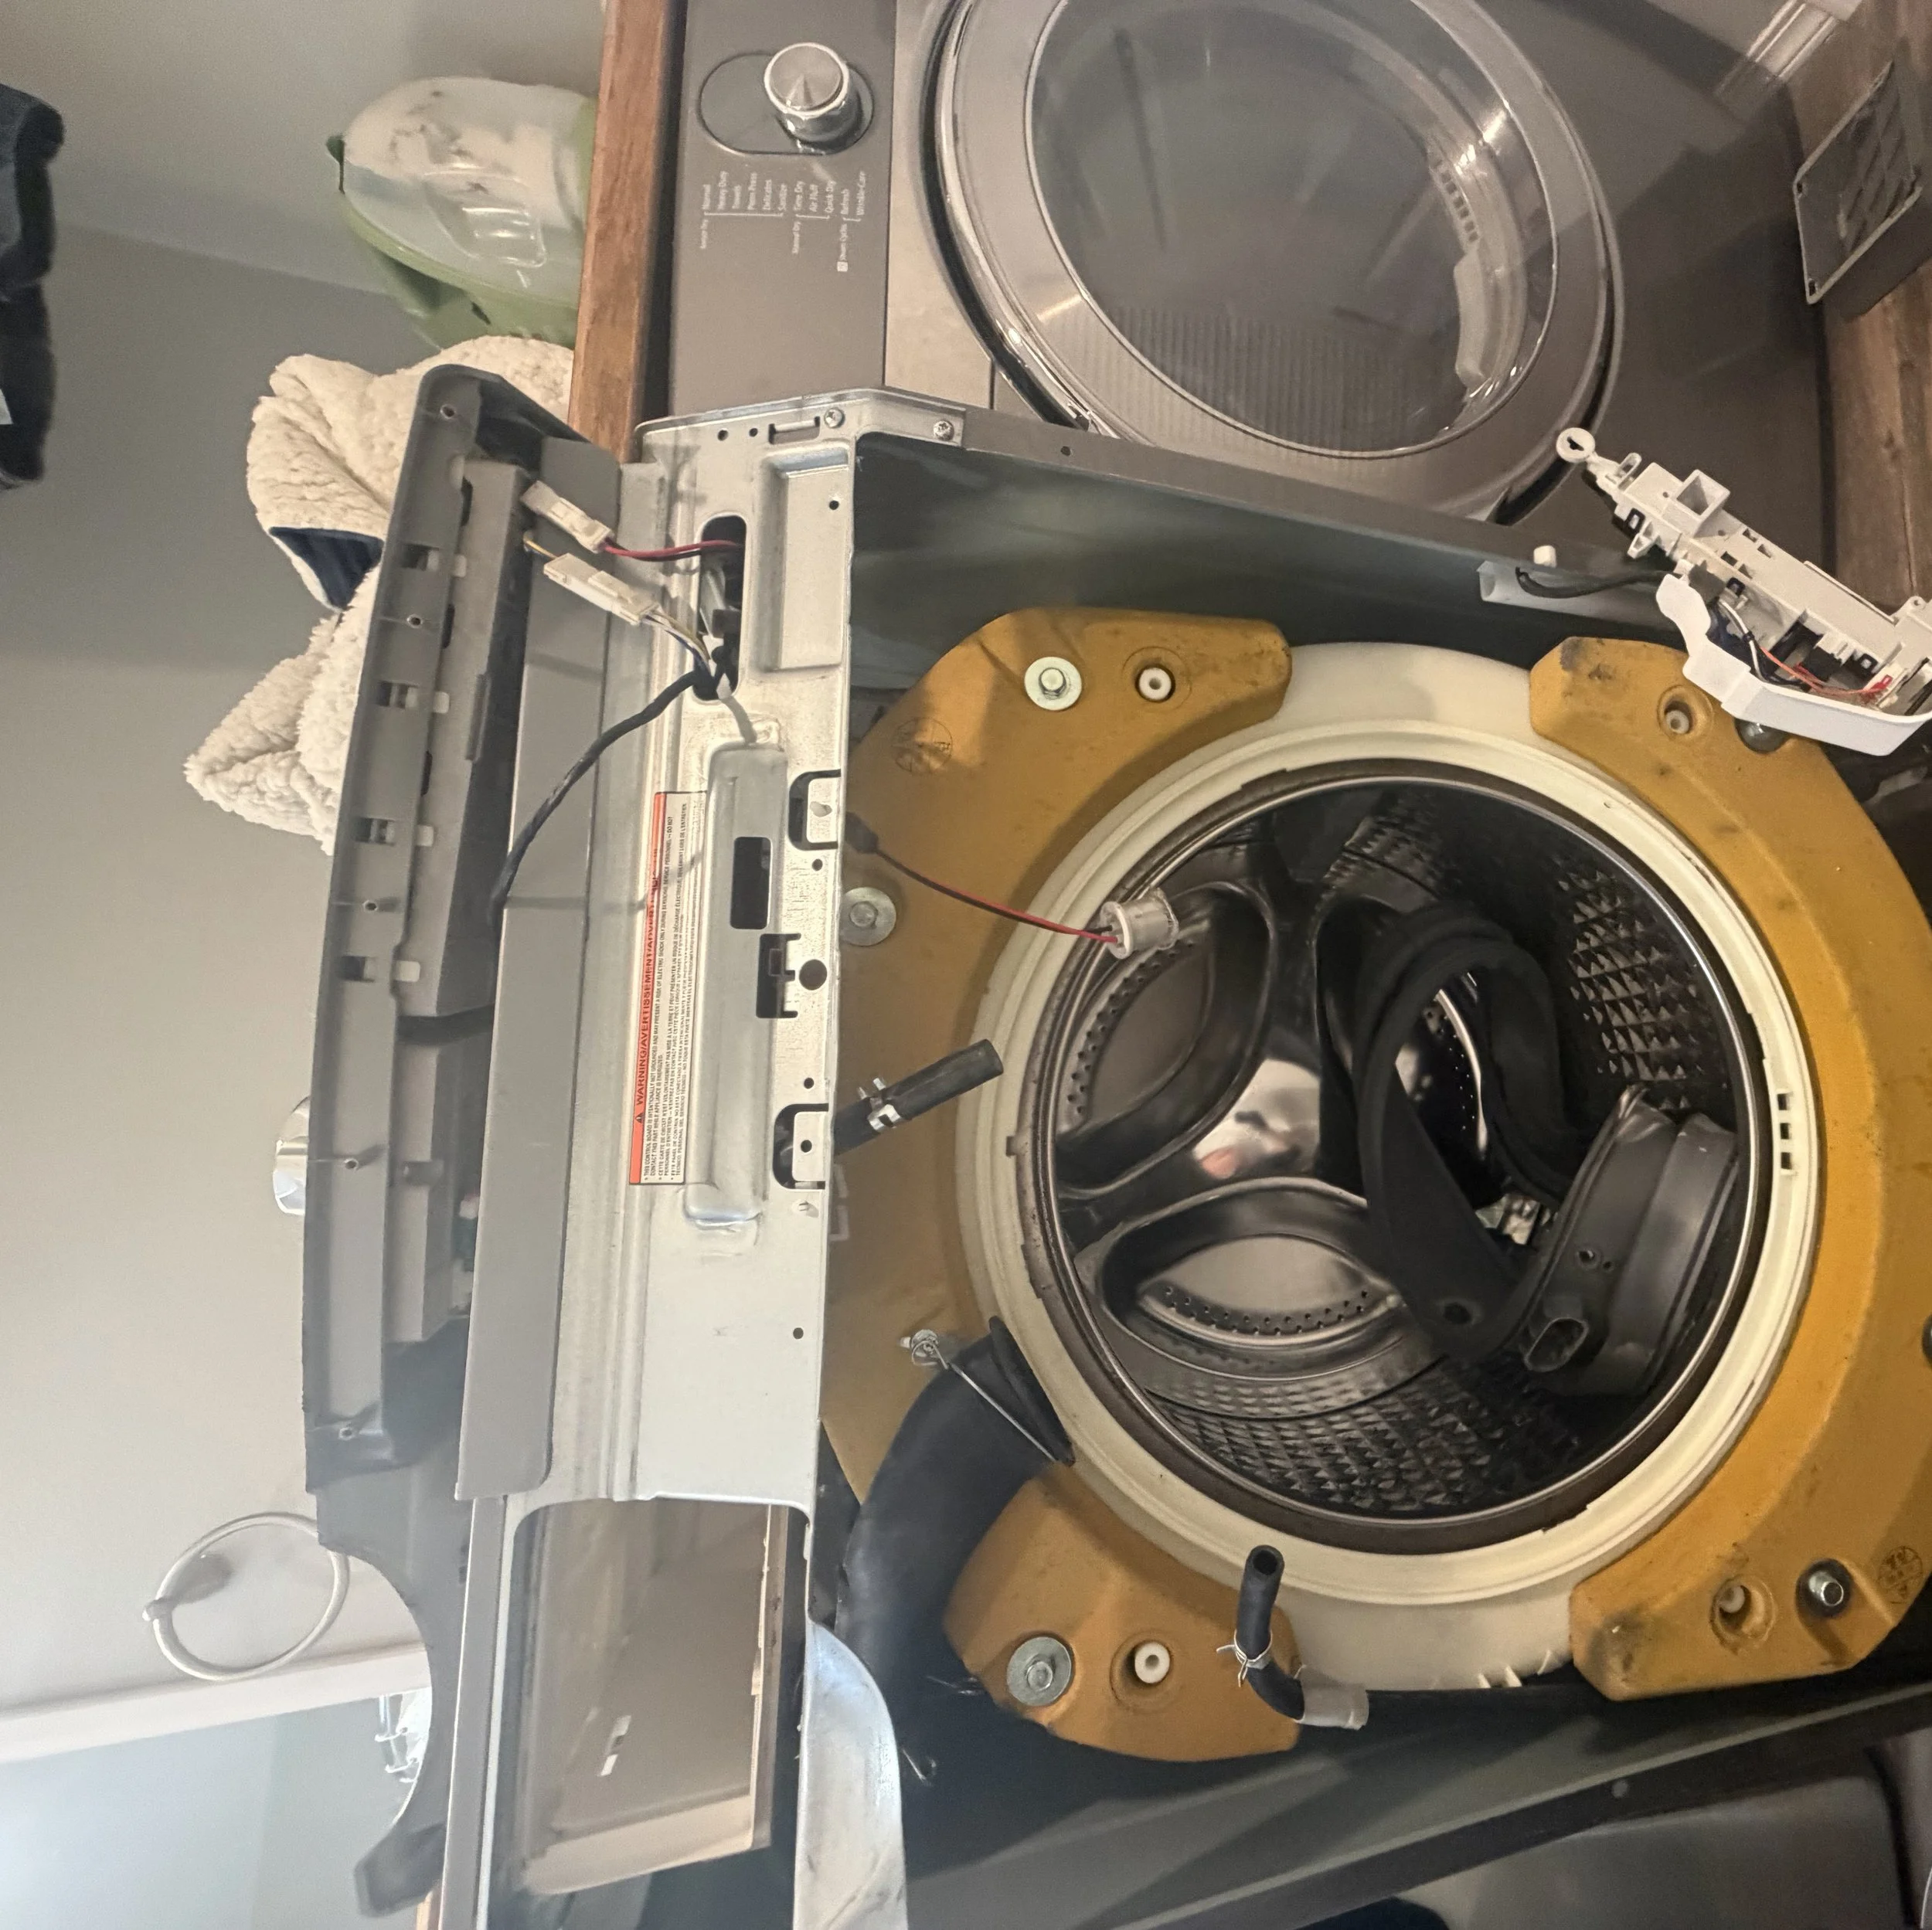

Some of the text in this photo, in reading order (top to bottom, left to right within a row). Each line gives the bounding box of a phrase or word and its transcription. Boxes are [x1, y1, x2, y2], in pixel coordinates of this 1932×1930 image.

[701, 184, 711, 210] Normal
[717, 171, 729, 210] Heavy Duty
[747, 172, 758, 192] Press
[762, 179, 773, 210] Delicates
[794, 181, 805, 212] Time Dry
[825, 180, 837, 213] Quick Dry
[777, 183, 788, 212] Sanitize
[809, 184, 818, 212] Air Fluff
